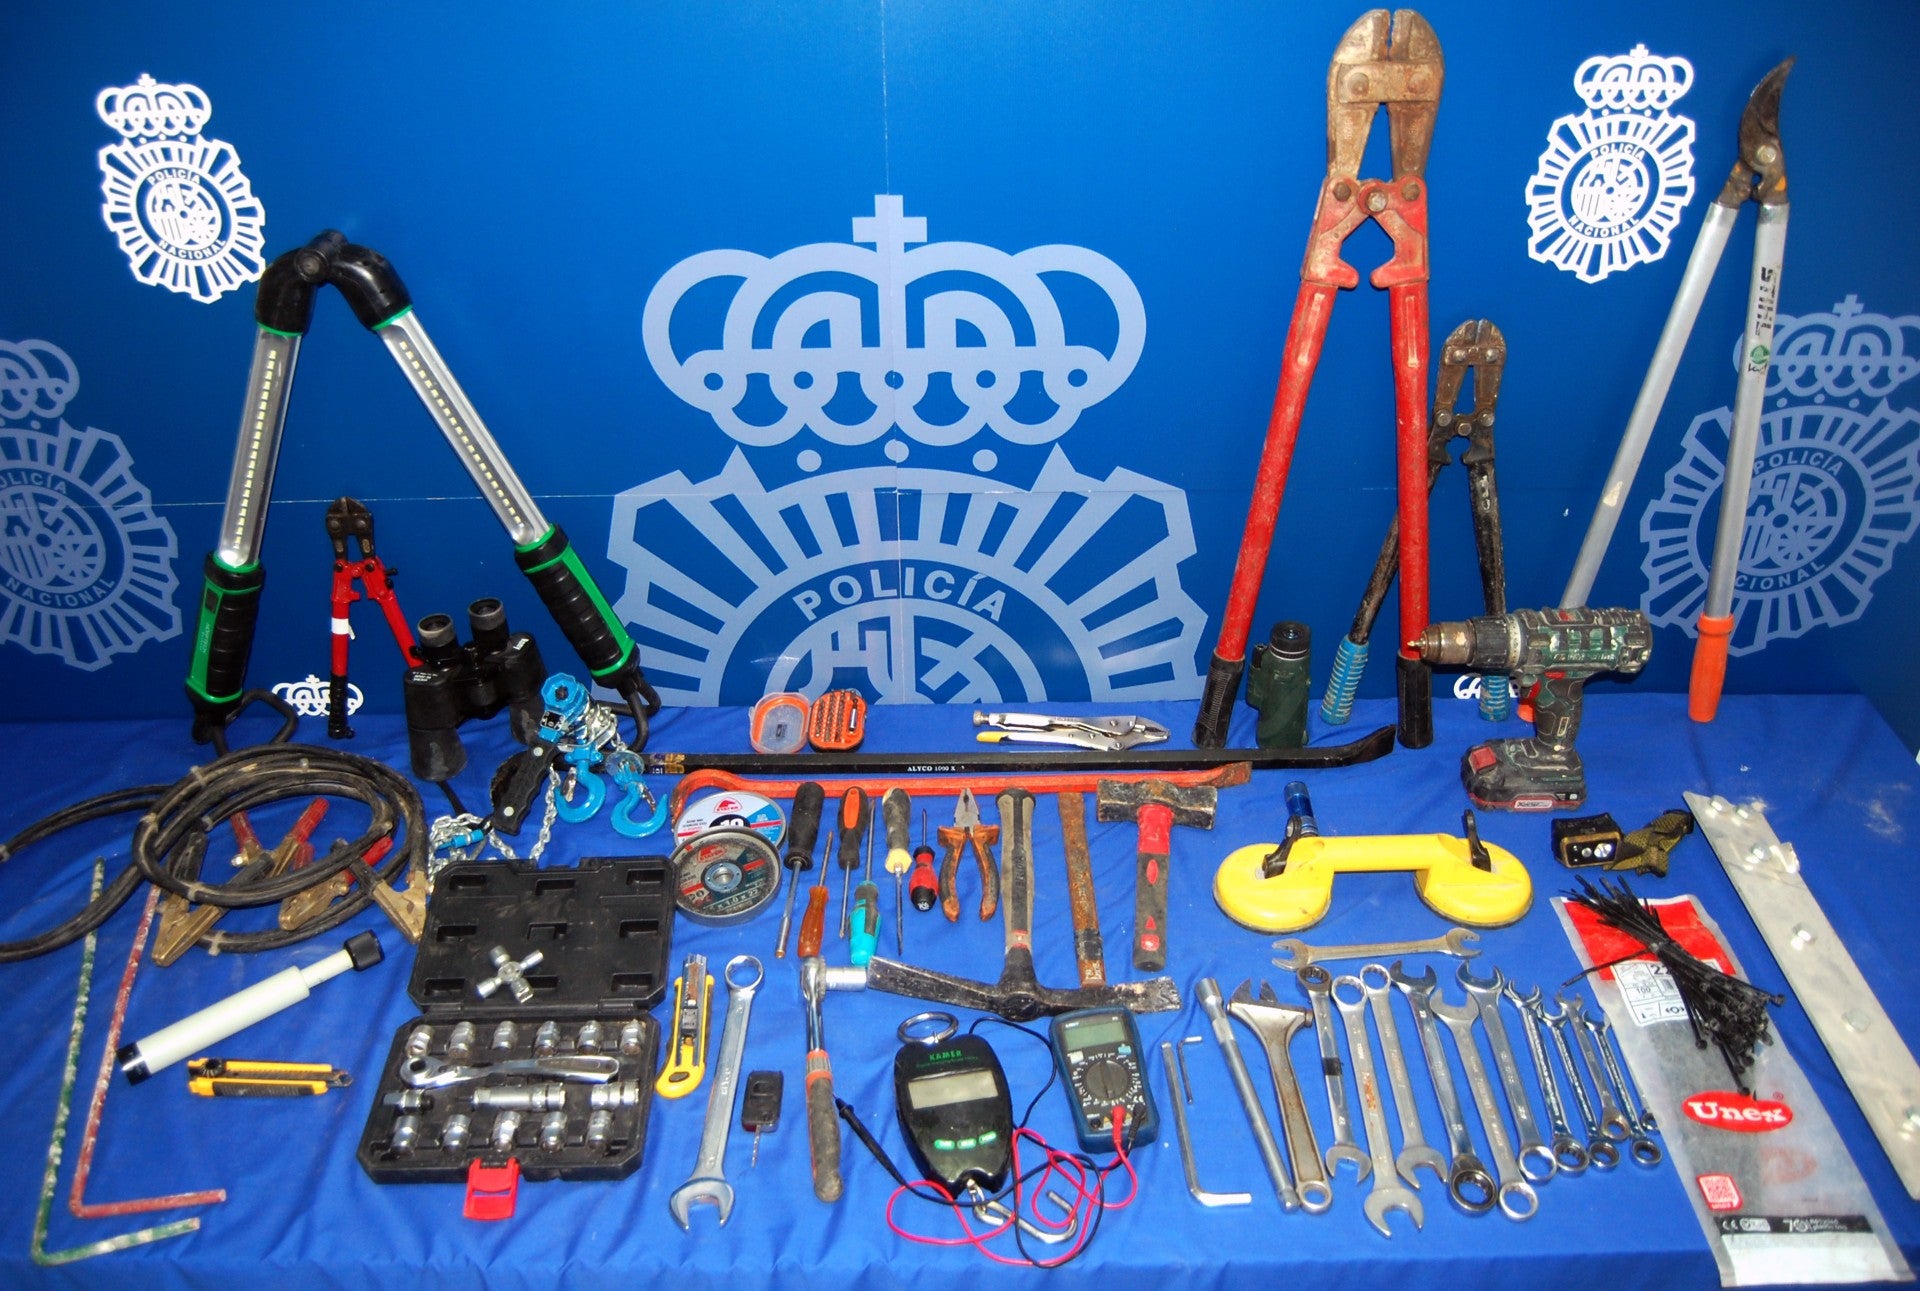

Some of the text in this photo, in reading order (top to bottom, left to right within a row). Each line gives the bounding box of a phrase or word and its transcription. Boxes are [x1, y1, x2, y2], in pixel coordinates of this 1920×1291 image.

[1568, 215, 1640, 238] NACIONAL
[159, 239, 227, 260] NACIONAL
[0, 470, 67, 494] OLICÍA
[1735, 561, 1826, 590] CIONAL
[6, 577, 116, 607] NACIONAL
[792, 566, 1007, 622] POLICÍA
[1687, 1101, 1788, 1123] Unex
